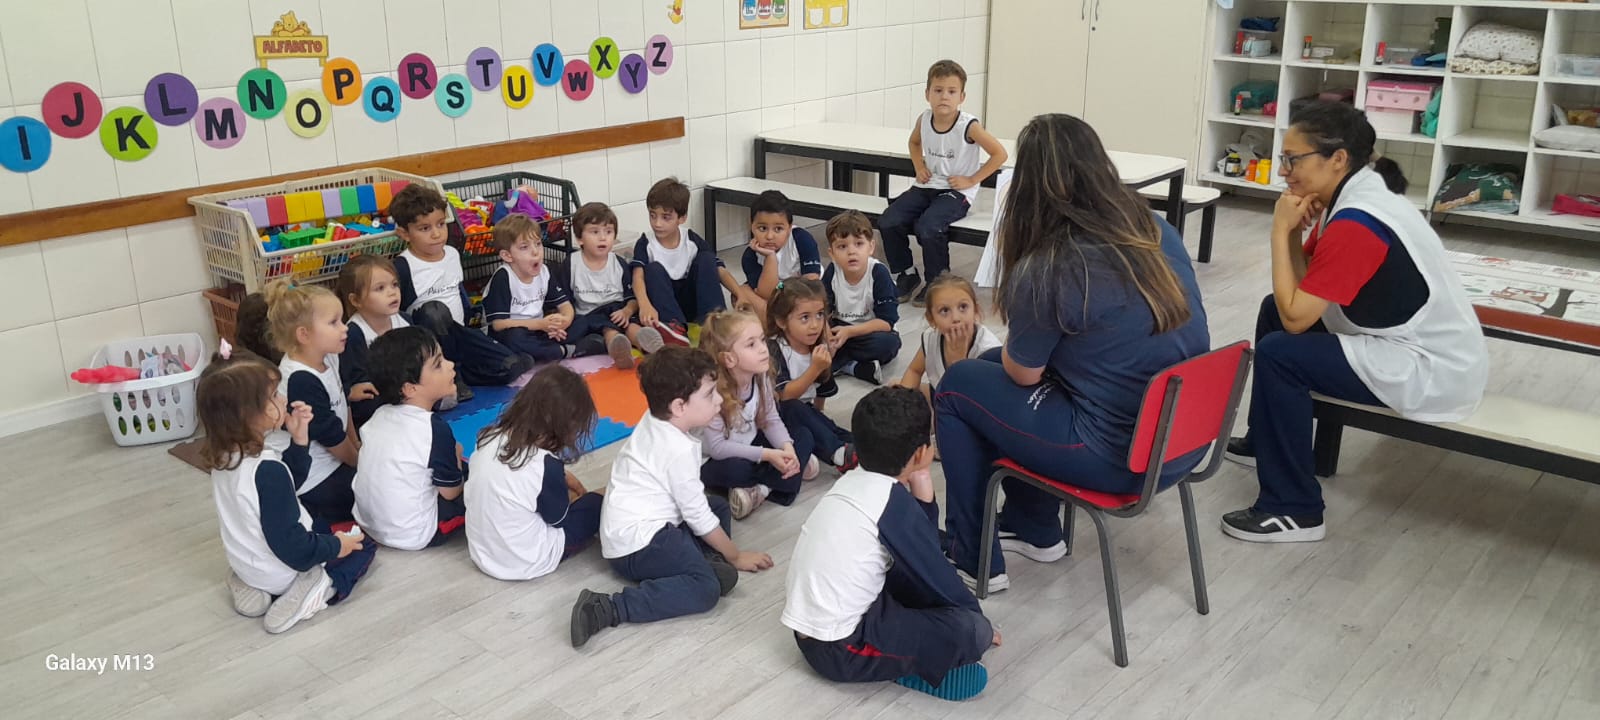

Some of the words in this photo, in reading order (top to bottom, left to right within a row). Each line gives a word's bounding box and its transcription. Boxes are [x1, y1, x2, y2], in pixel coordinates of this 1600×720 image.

[262, 39, 323, 54] ALFABETO
[17, 126, 32, 161] I
[61, 92, 85, 128] J
[114, 114, 151, 152] K
[157, 83, 188, 117] L
[204, 107, 238, 141] M
[247, 78, 275, 112] N
[295, 97, 322, 129] O
[333, 68, 354, 100] P
[371, 85, 395, 113] Q
[407, 62, 432, 92] R
[446, 81, 465, 109] S
[476, 58, 494, 87] T
[507, 75, 526, 102] U
[536, 52, 555, 78] V
[567, 71, 588, 92] W
[595, 44, 612, 71] X
[624, 62, 641, 89] Y
[652, 41, 667, 67] Z
